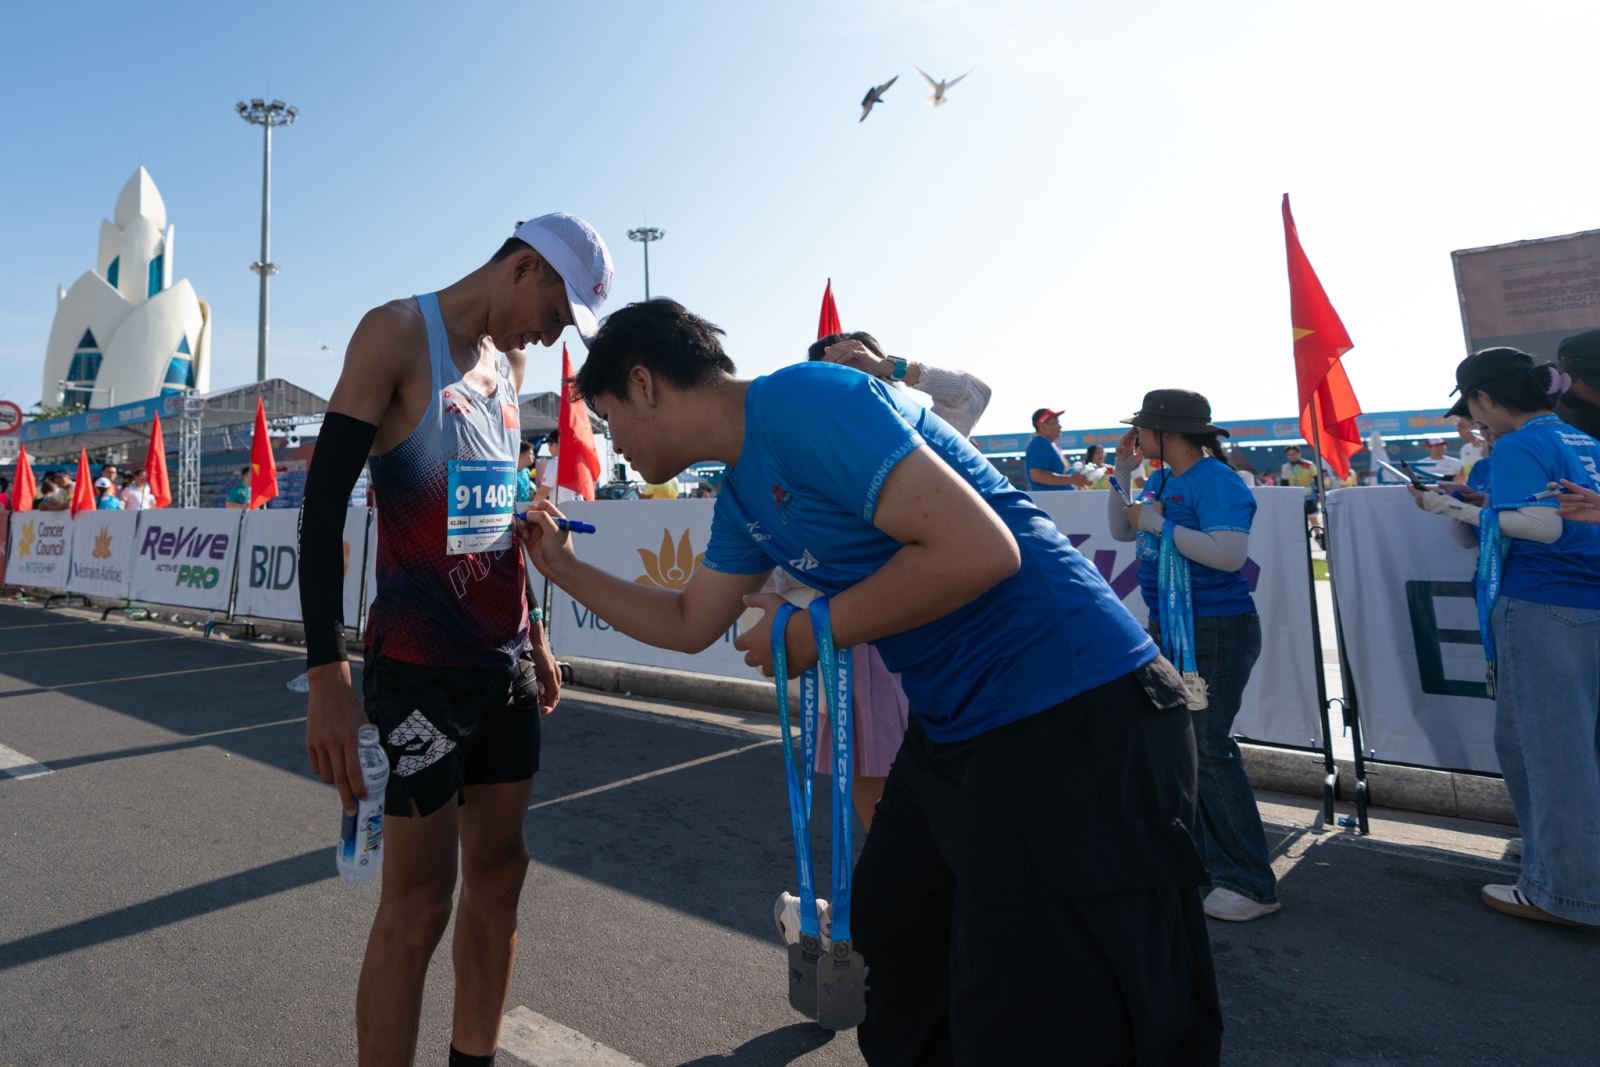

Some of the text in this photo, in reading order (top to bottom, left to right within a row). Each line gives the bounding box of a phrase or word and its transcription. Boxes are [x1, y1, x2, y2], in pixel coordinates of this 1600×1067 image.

[866, 458, 895, 501] PHONG
[38, 521, 65, 538] Cancer
[36, 539, 66, 556] Council
[457, 540, 463, 548] 2
[156, 564, 178, 573] ACTIVE
[175, 564, 220, 590] PRO
[249, 545, 298, 591] BID
[838, 668, 848, 794] 42,195KM
